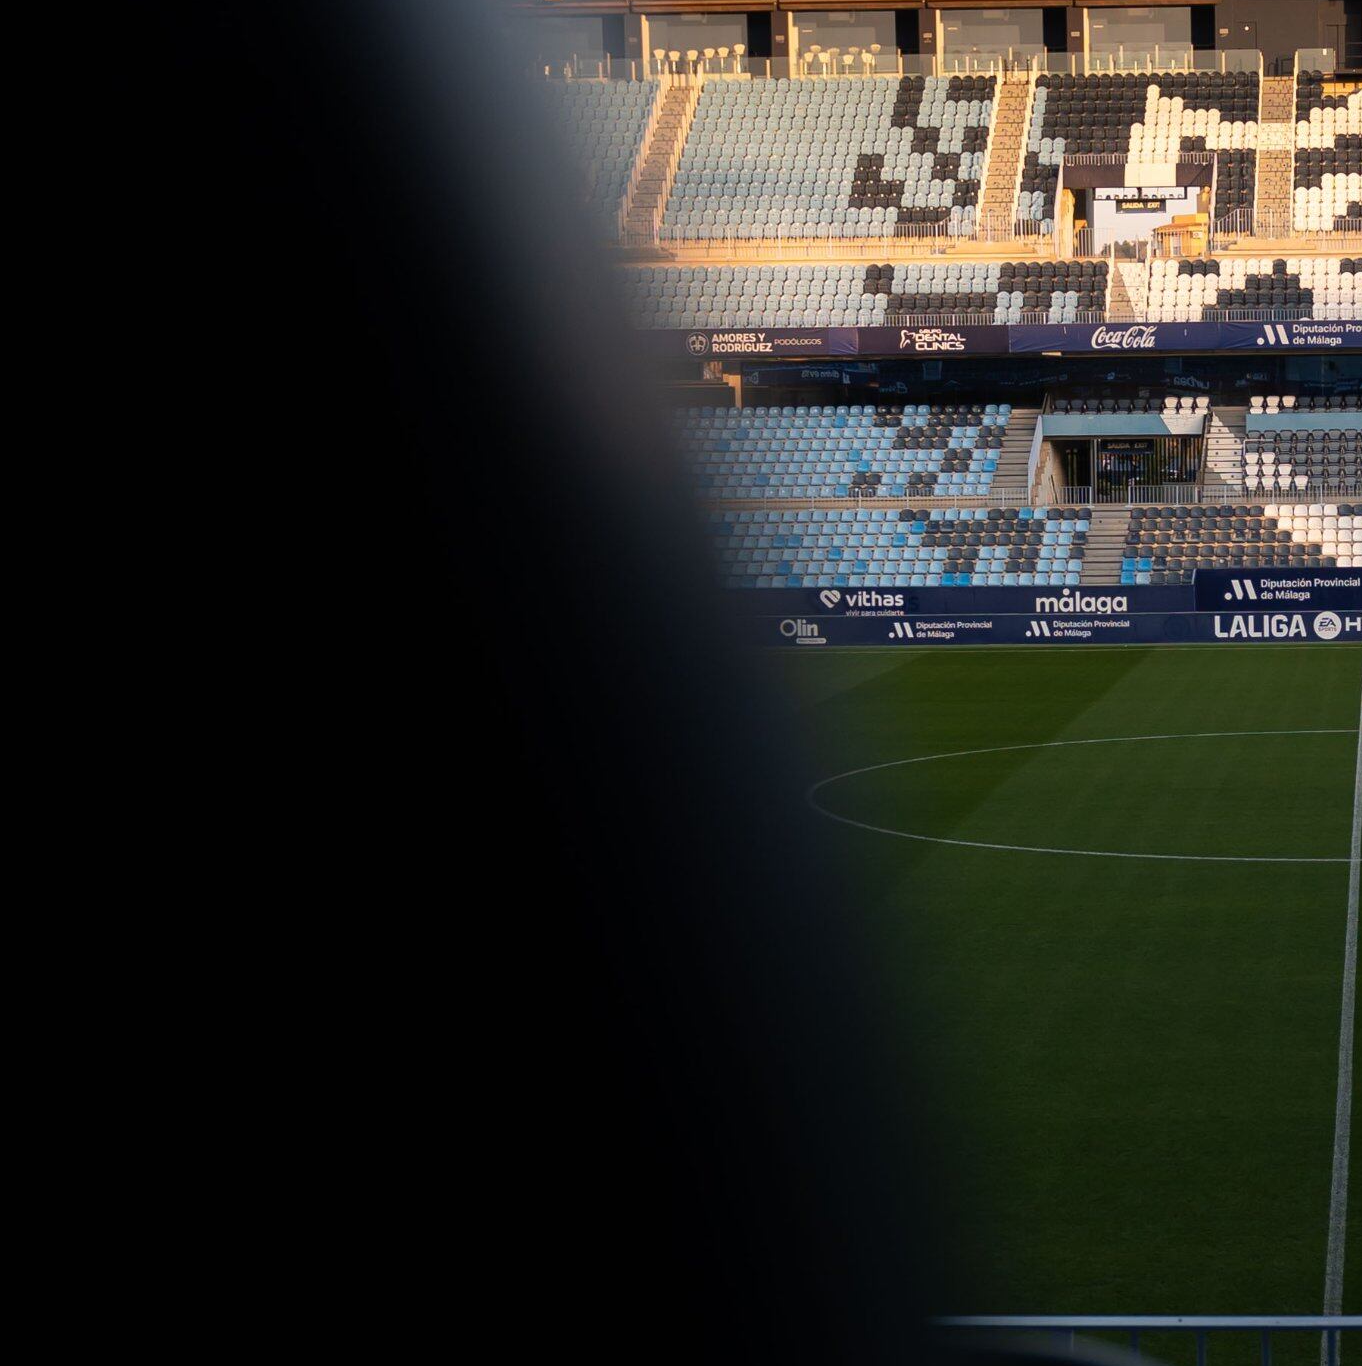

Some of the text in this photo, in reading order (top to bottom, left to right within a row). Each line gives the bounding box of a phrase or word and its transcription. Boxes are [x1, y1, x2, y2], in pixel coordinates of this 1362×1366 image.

[1293, 324, 1343, 335] Diputación
[711, 333, 766, 344] AMORES Y
[915, 333, 966, 342] DENTAL
[1091, 325, 1158, 349] Coca-Cola
[1293, 335, 1342, 346] de Málaga
[712, 340, 773, 353] RODRÍGUEZ
[915, 341, 964, 351] CLINICS
[1261, 577, 1360, 590] Diputación Provincial
[846, 591, 904, 607] vithas
[1261, 590, 1310, 601] de Málaga
[780, 619, 818, 636] Olin
[916, 620, 993, 630] Diputación Provincial
[1053, 620, 1130, 629] Diputación Provincial
[1214, 614, 1307, 638] LALIGA
[1318, 618, 1337, 627] EA
[928, 630, 954, 639] Málaga
[1065, 629, 1091, 638] Málaga
